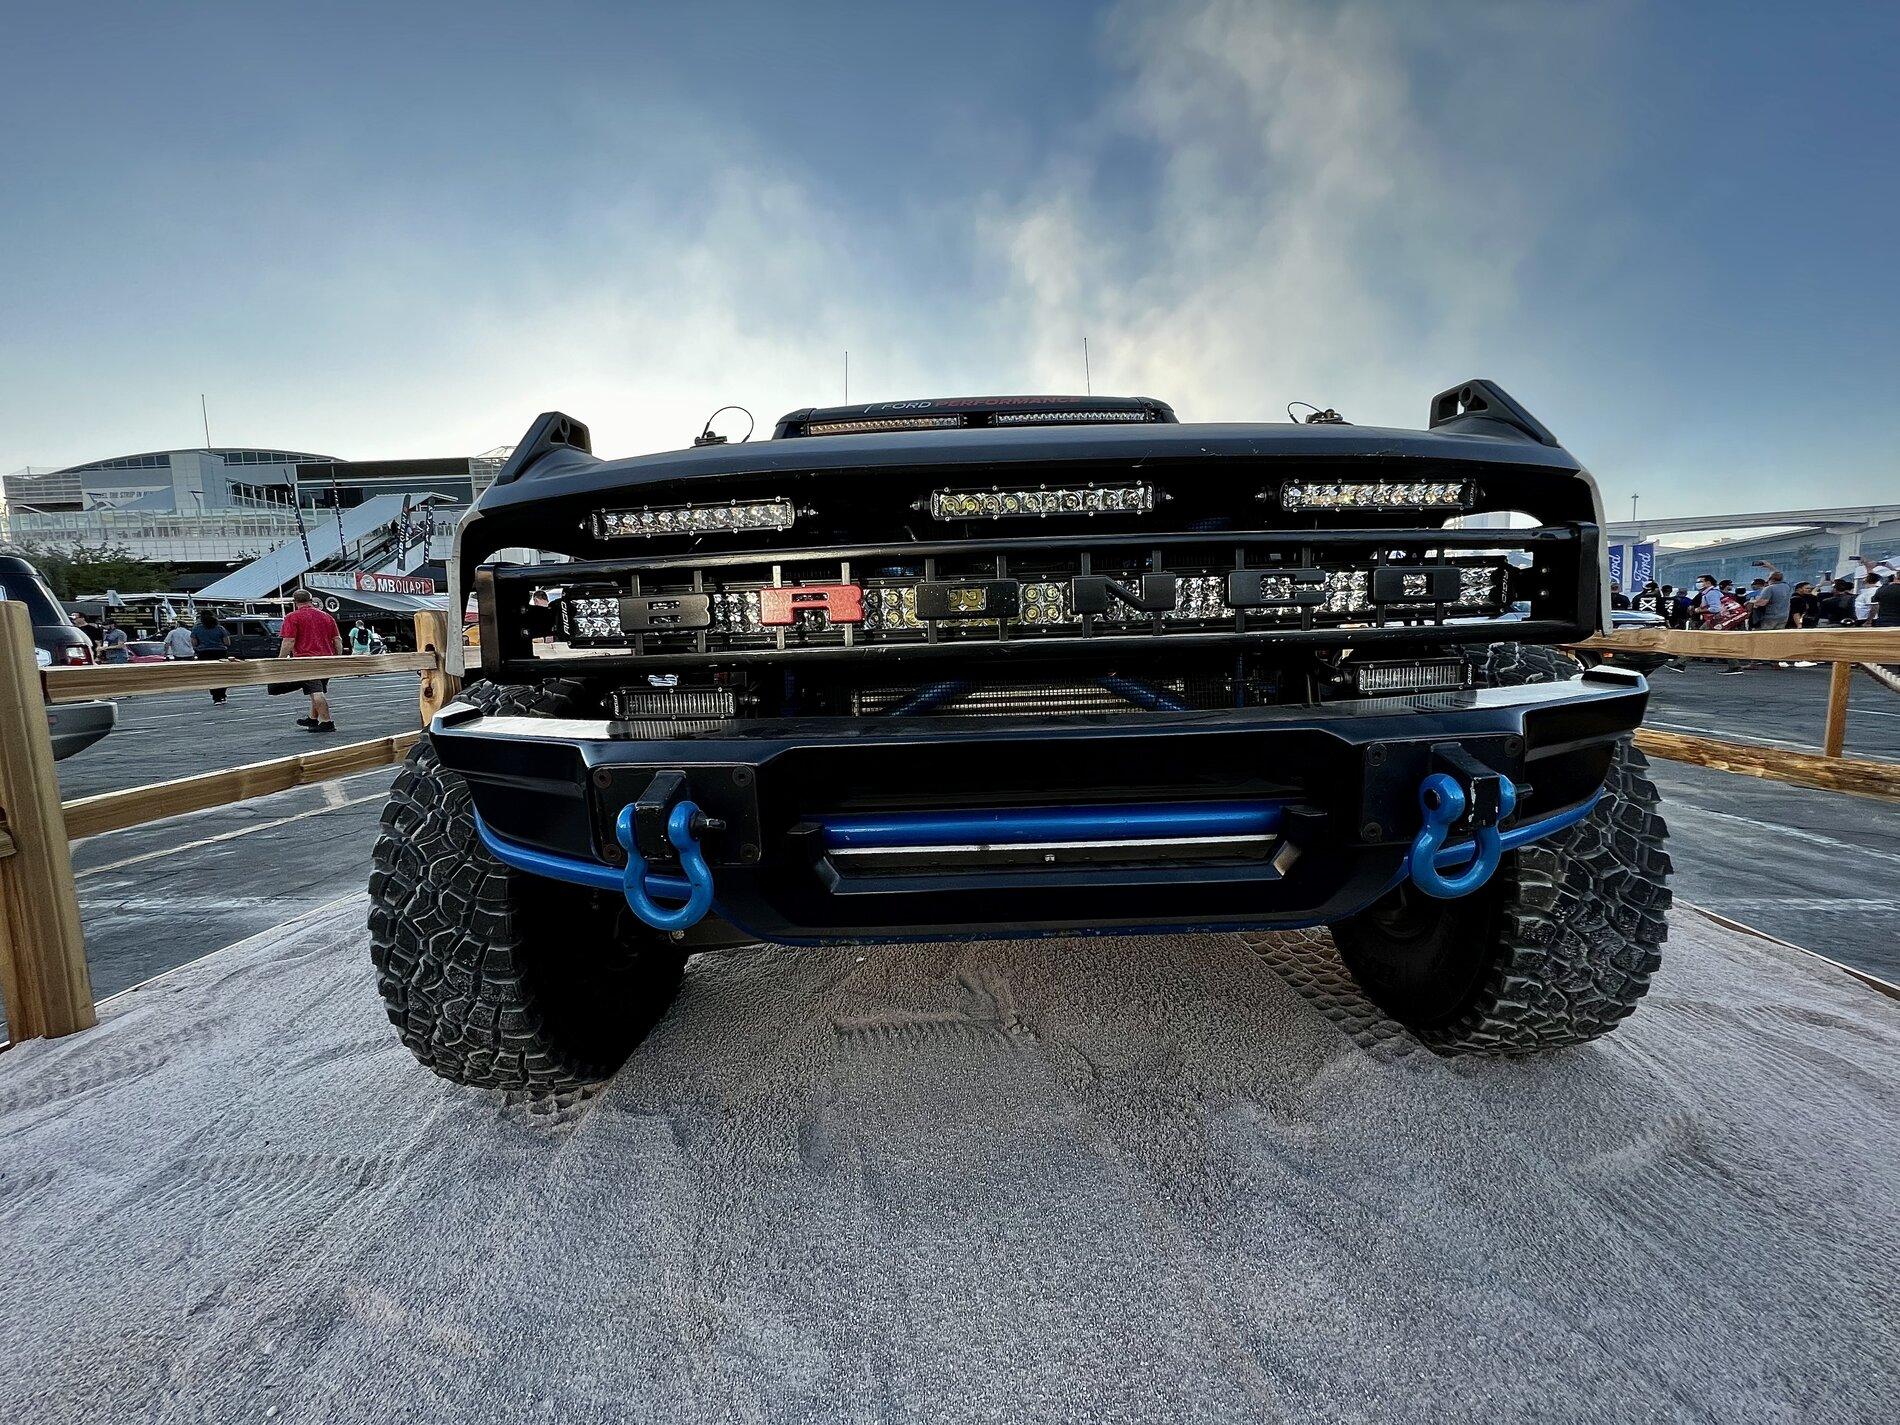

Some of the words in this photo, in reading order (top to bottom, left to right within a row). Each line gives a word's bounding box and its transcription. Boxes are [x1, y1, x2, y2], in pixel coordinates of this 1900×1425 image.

[881, 401, 932, 410] FORD
[934, 397, 1081, 408] PERFORMANCE
[1633, 552, 1651, 588] Ford
[561, 601, 571, 636] RIGID
